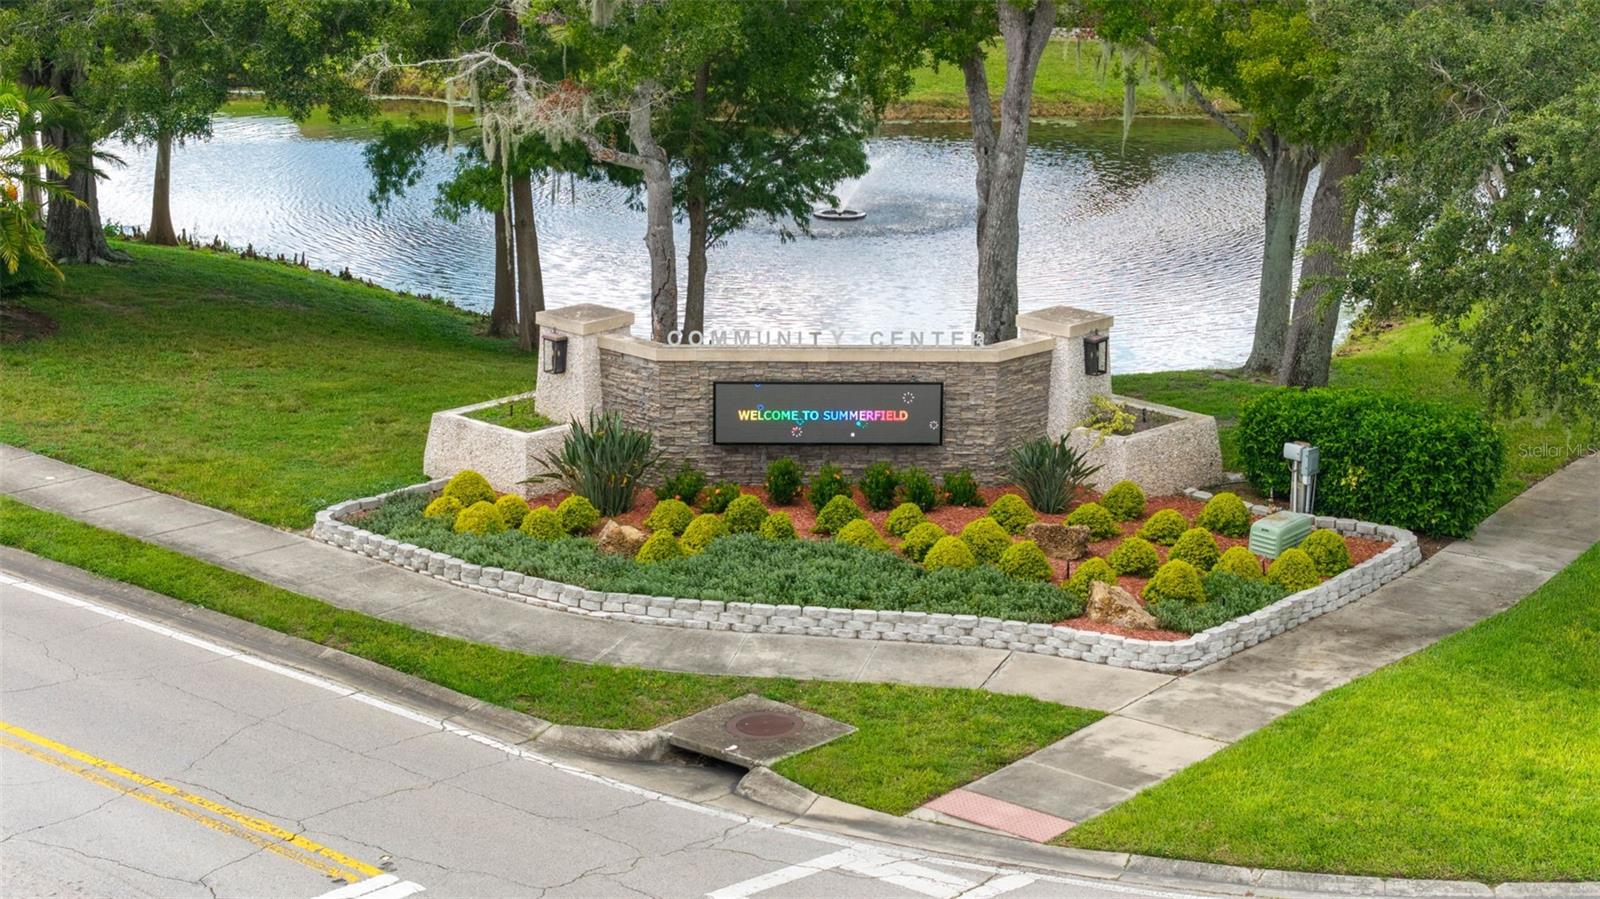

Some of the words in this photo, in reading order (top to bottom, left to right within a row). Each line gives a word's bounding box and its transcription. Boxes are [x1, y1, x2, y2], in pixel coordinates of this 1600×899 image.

[667, 331, 845, 346] COMMUNITY
[870, 331, 985, 347] CENTER
[738, 409, 798, 421] WELCOME
[802, 409, 819, 421] TO
[823, 409, 909, 421] SUMMERFIELD
